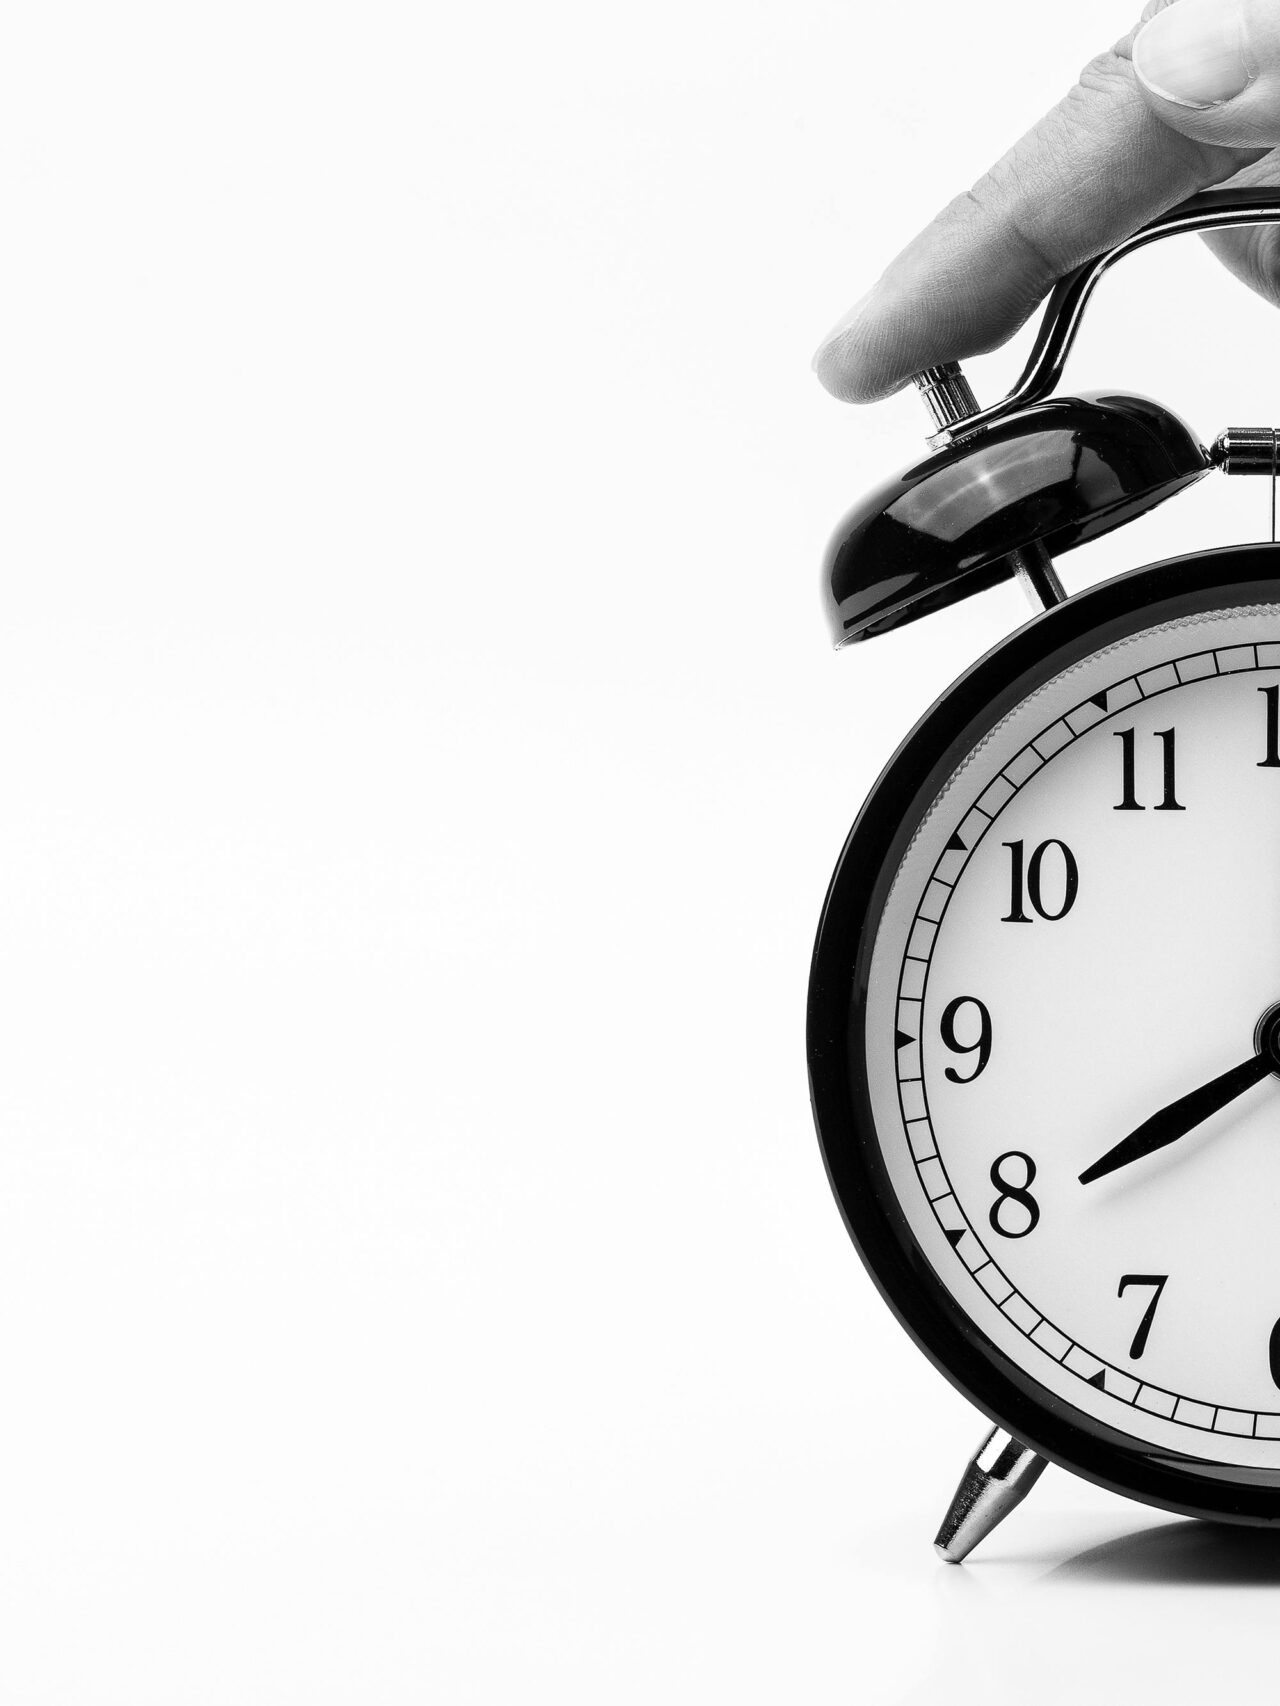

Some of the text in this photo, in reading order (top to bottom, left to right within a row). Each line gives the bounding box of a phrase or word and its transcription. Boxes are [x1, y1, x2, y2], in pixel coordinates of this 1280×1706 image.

[1112, 726, 1187, 811] 11
[1000, 838, 1079, 924] 10
[939, 995, 993, 1084] 9
[988, 1150, 1040, 1239] 8
[1117, 1274, 1169, 1360] 7
